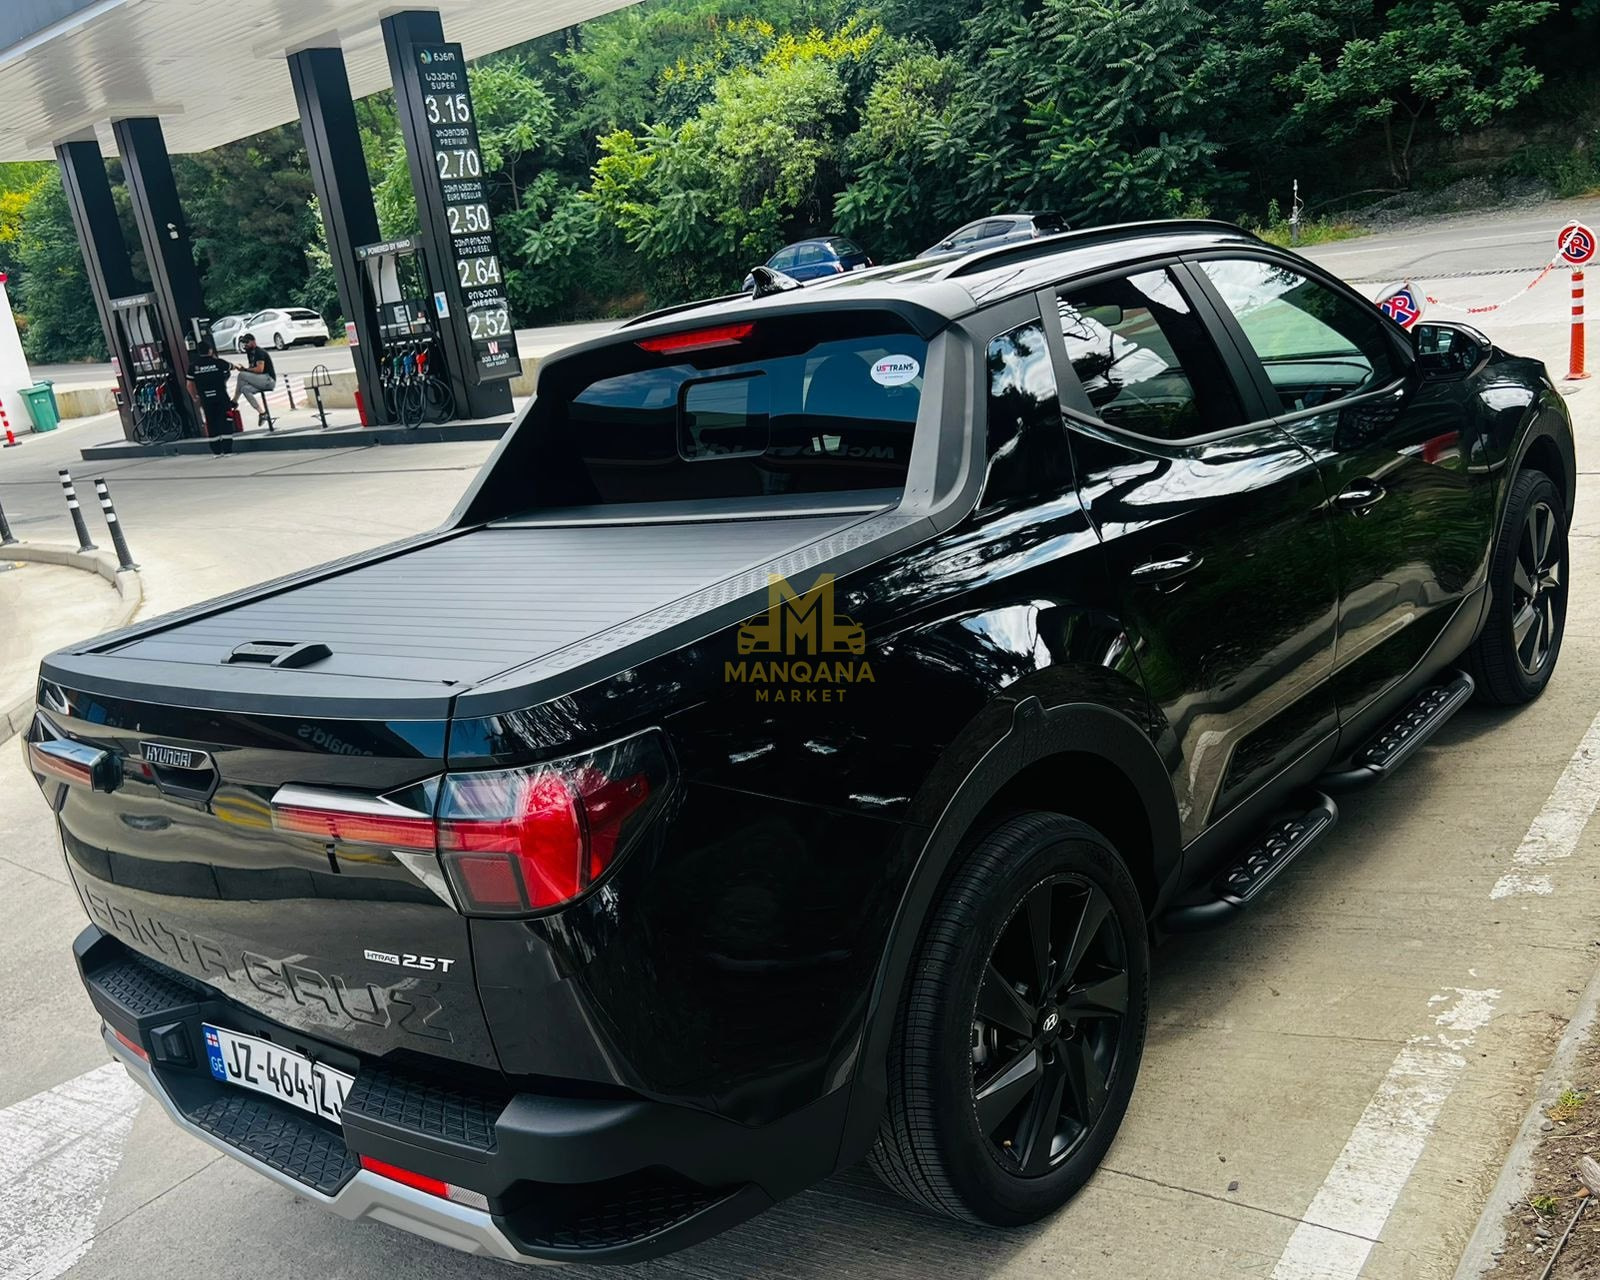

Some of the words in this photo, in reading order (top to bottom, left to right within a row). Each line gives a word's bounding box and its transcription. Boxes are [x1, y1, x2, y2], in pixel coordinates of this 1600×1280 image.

[433, 52, 455, 61] ნანო
[425, 72, 457, 81] სუპერი
[431, 81, 456, 90] SUPER
[425, 94, 470, 123] 3.15
[440, 137, 468, 146] PREMIUM
[436, 149, 480, 179] 2.70
[447, 192, 460, 201] EURO
[461, 190, 482, 200] REGULAR
[447, 204, 490, 234] 2.50
[459, 246, 472, 255] EURO
[473, 245, 490, 253] DIESEL
[458, 256, 500, 287] 2.64
[468, 288, 498, 299] დიზელი
[472, 297, 497, 308] DIESEL
[468, 310, 511, 340] 2.52
[146, 746, 192, 768] HYUNDAI
[366, 952, 398, 964] HTRAC
[84, 885, 237, 983] SANTA
[241, 951, 455, 1045] CRUZ
[210, 1056, 225, 1073] GE
